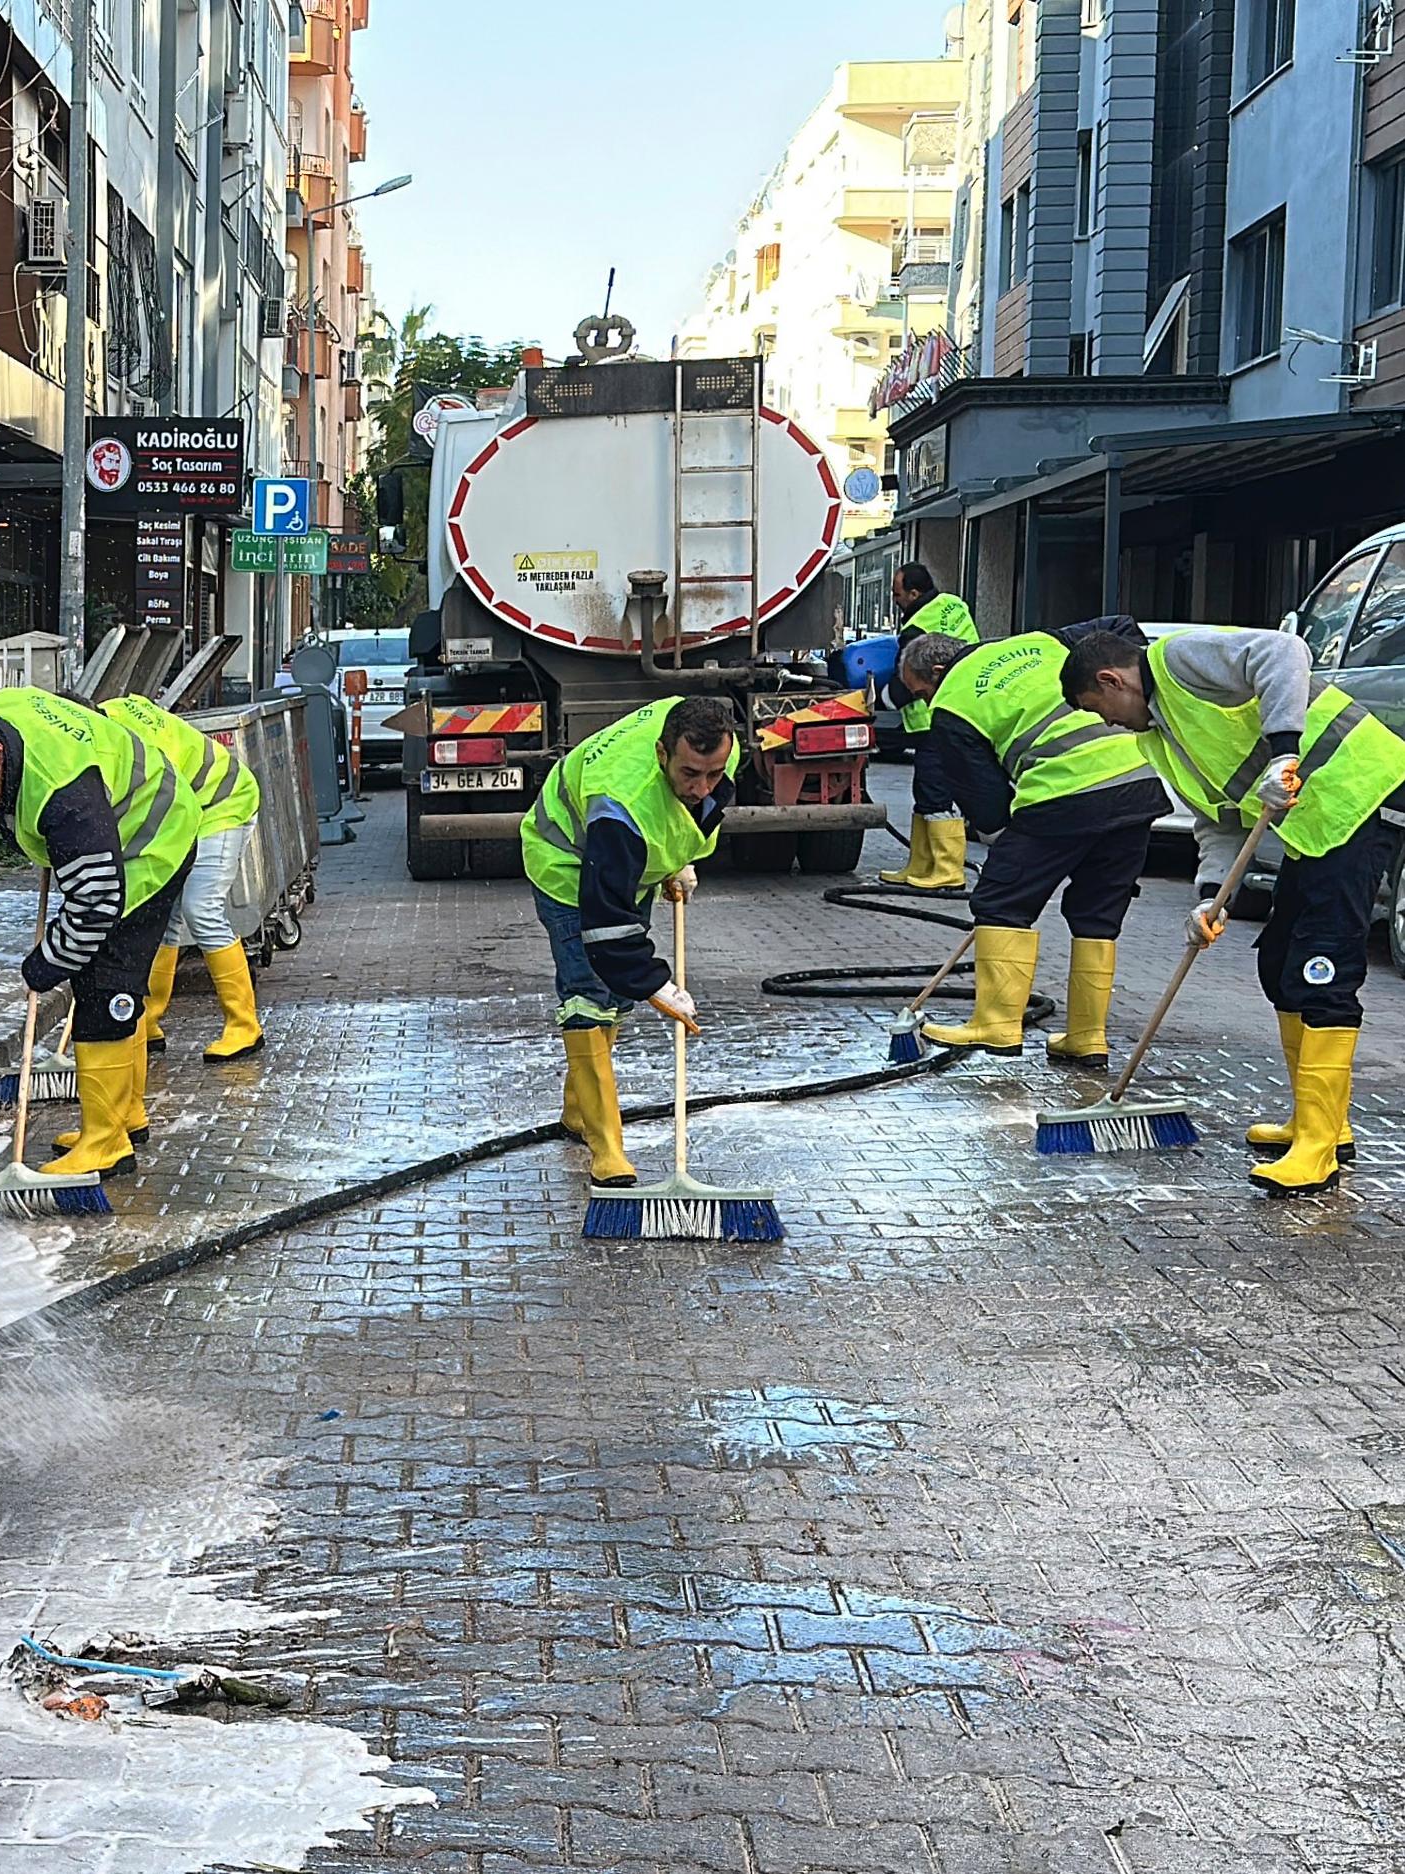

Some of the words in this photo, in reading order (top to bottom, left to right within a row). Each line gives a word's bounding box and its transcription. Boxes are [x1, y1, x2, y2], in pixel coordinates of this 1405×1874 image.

[136, 427, 238, 449] KADİROĞLU
[151, 457, 173, 474] Saç
[175, 458, 223, 472] Tasarım
[137, 481, 169, 493] 0533
[172, 481, 196, 494] 466
[200, 482, 216, 494] 26
[219, 482, 236, 494] 80
[265, 484, 296, 530] P
[138, 520, 153, 533] Saç
[154, 520, 181, 530] Kesimi
[136, 536, 159, 546] Sakal
[148, 570, 169, 581] Boya
[517, 572, 528, 582] 25
[530, 571, 570, 582] METREDEN
[571, 570, 594, 580] FAZLA
[535, 581, 576, 594] YAKLAŞMA
[146, 615, 172, 625] Perma
[432, 773, 449, 789] 34
[457, 772, 484, 788] GEA
[491, 772, 518, 788] 204
